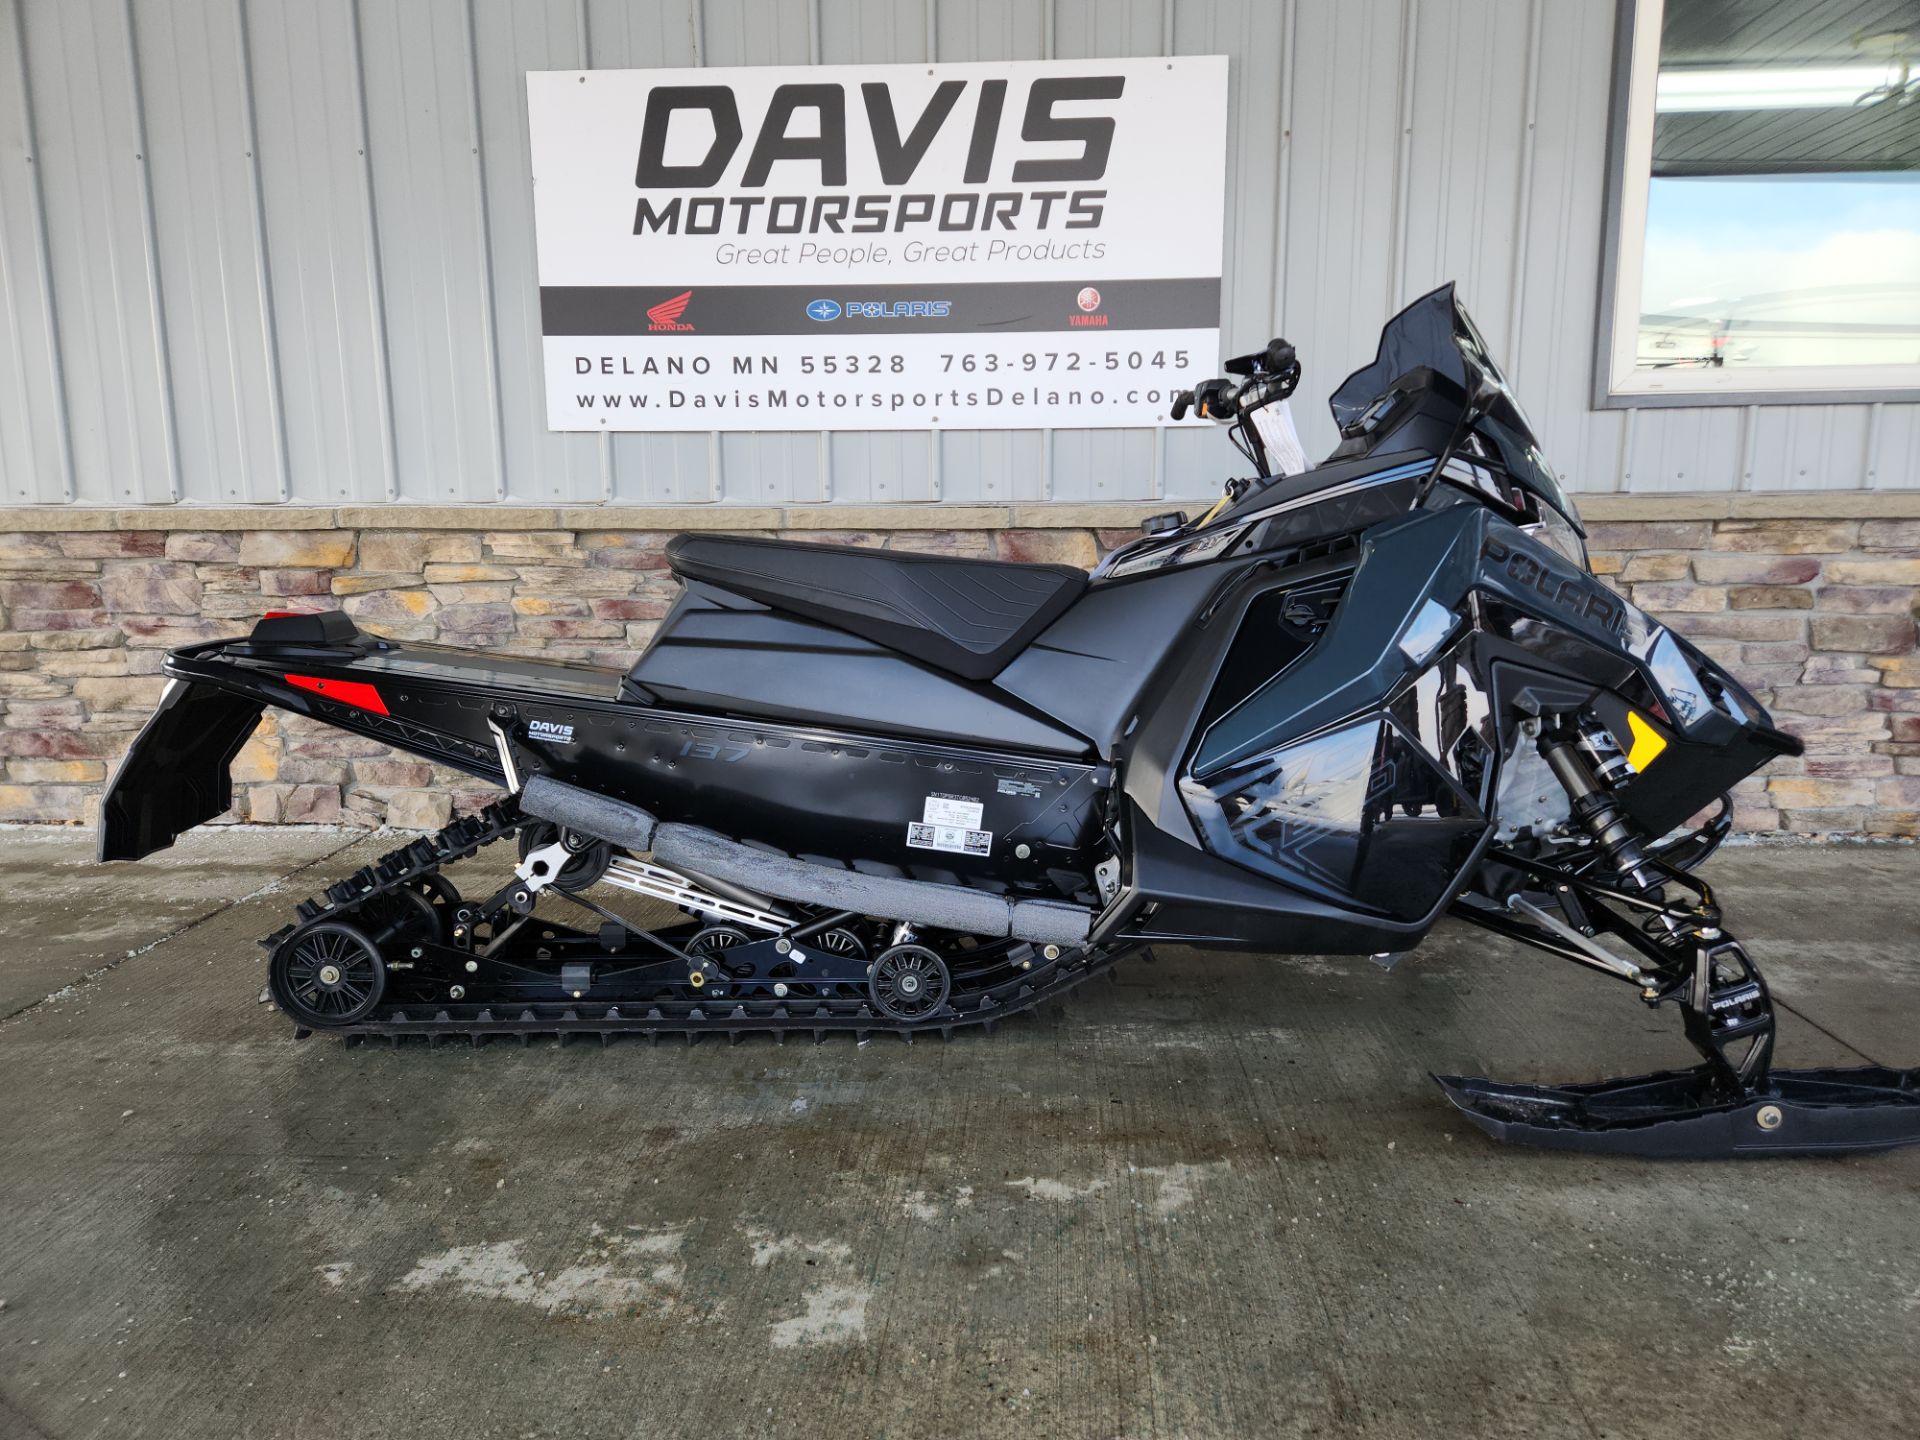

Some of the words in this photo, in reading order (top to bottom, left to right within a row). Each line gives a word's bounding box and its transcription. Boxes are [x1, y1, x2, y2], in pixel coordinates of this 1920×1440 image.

[635, 75, 1126, 188] DAVIS
[633, 190, 1108, 235] MOTORSPORTS
[715, 243, 790, 265] Great
[798, 242, 892, 269] People,
[903, 240, 980, 263] Great
[987, 238, 1107, 262] Products
[846, 300, 951, 319] POLARIS
[647, 323, 695, 331] HONDA
[1068, 314, 1109, 327] YAMAHA
[575, 356, 711, 375] DELANO
[733, 356, 778, 375] MN
[801, 355, 905, 374] 55328
[940, 350, 1190, 374] 763-972-5045
[1480, 536, 1647, 647] POLARIS
[529, 720, 574, 736] DAVIS
[680, 741, 752, 762] 137
[1712, 990, 1760, 1010] POLARIS
